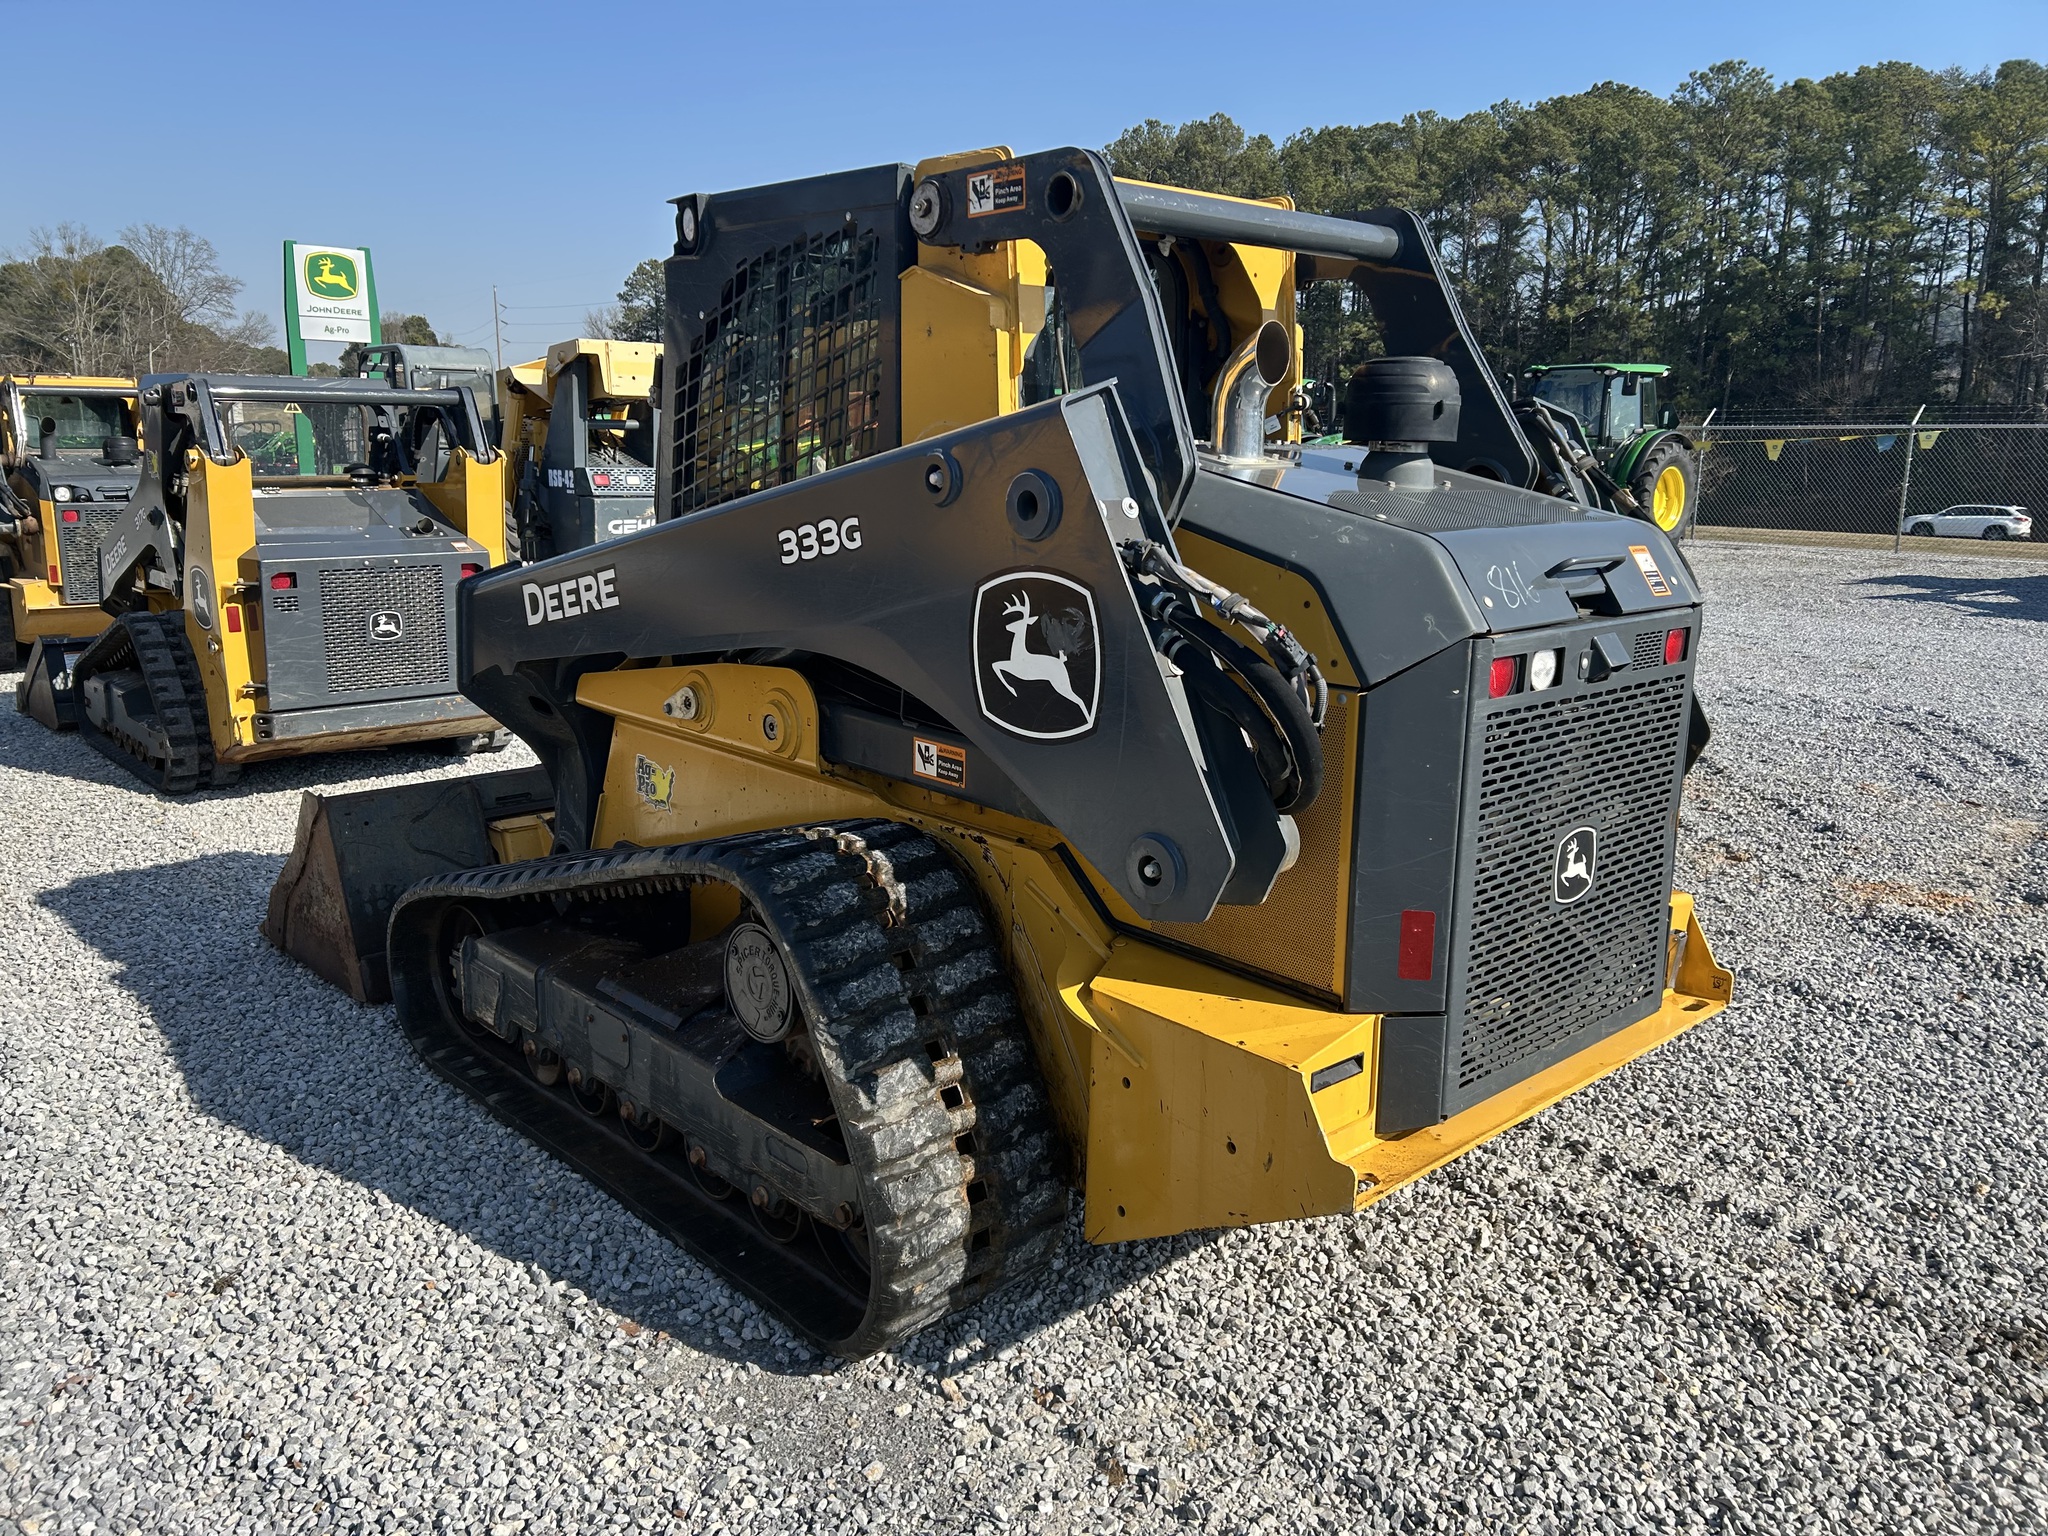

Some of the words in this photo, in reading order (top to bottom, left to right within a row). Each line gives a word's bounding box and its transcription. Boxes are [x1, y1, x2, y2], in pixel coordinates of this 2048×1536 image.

[995, 186, 1009, 195] Pinch
[1010, 185, 1022, 193] Area
[307, 305, 332, 314] JOHN
[333, 306, 362, 316] DEERE
[324, 325, 349, 334] Ag-Pro
[134, 507, 146, 531] 317G
[778, 517, 862, 565] 333G
[104, 534, 127, 576] DEERE
[522, 568, 620, 626] DEERE
[938, 760, 951, 769] Pinch
[952, 764, 962, 772] Area
[938, 768, 948, 776] Keep
[948, 771, 959, 779] Away
[637, 774, 656, 796] Pro
[736, 945, 761, 977] SPICER
